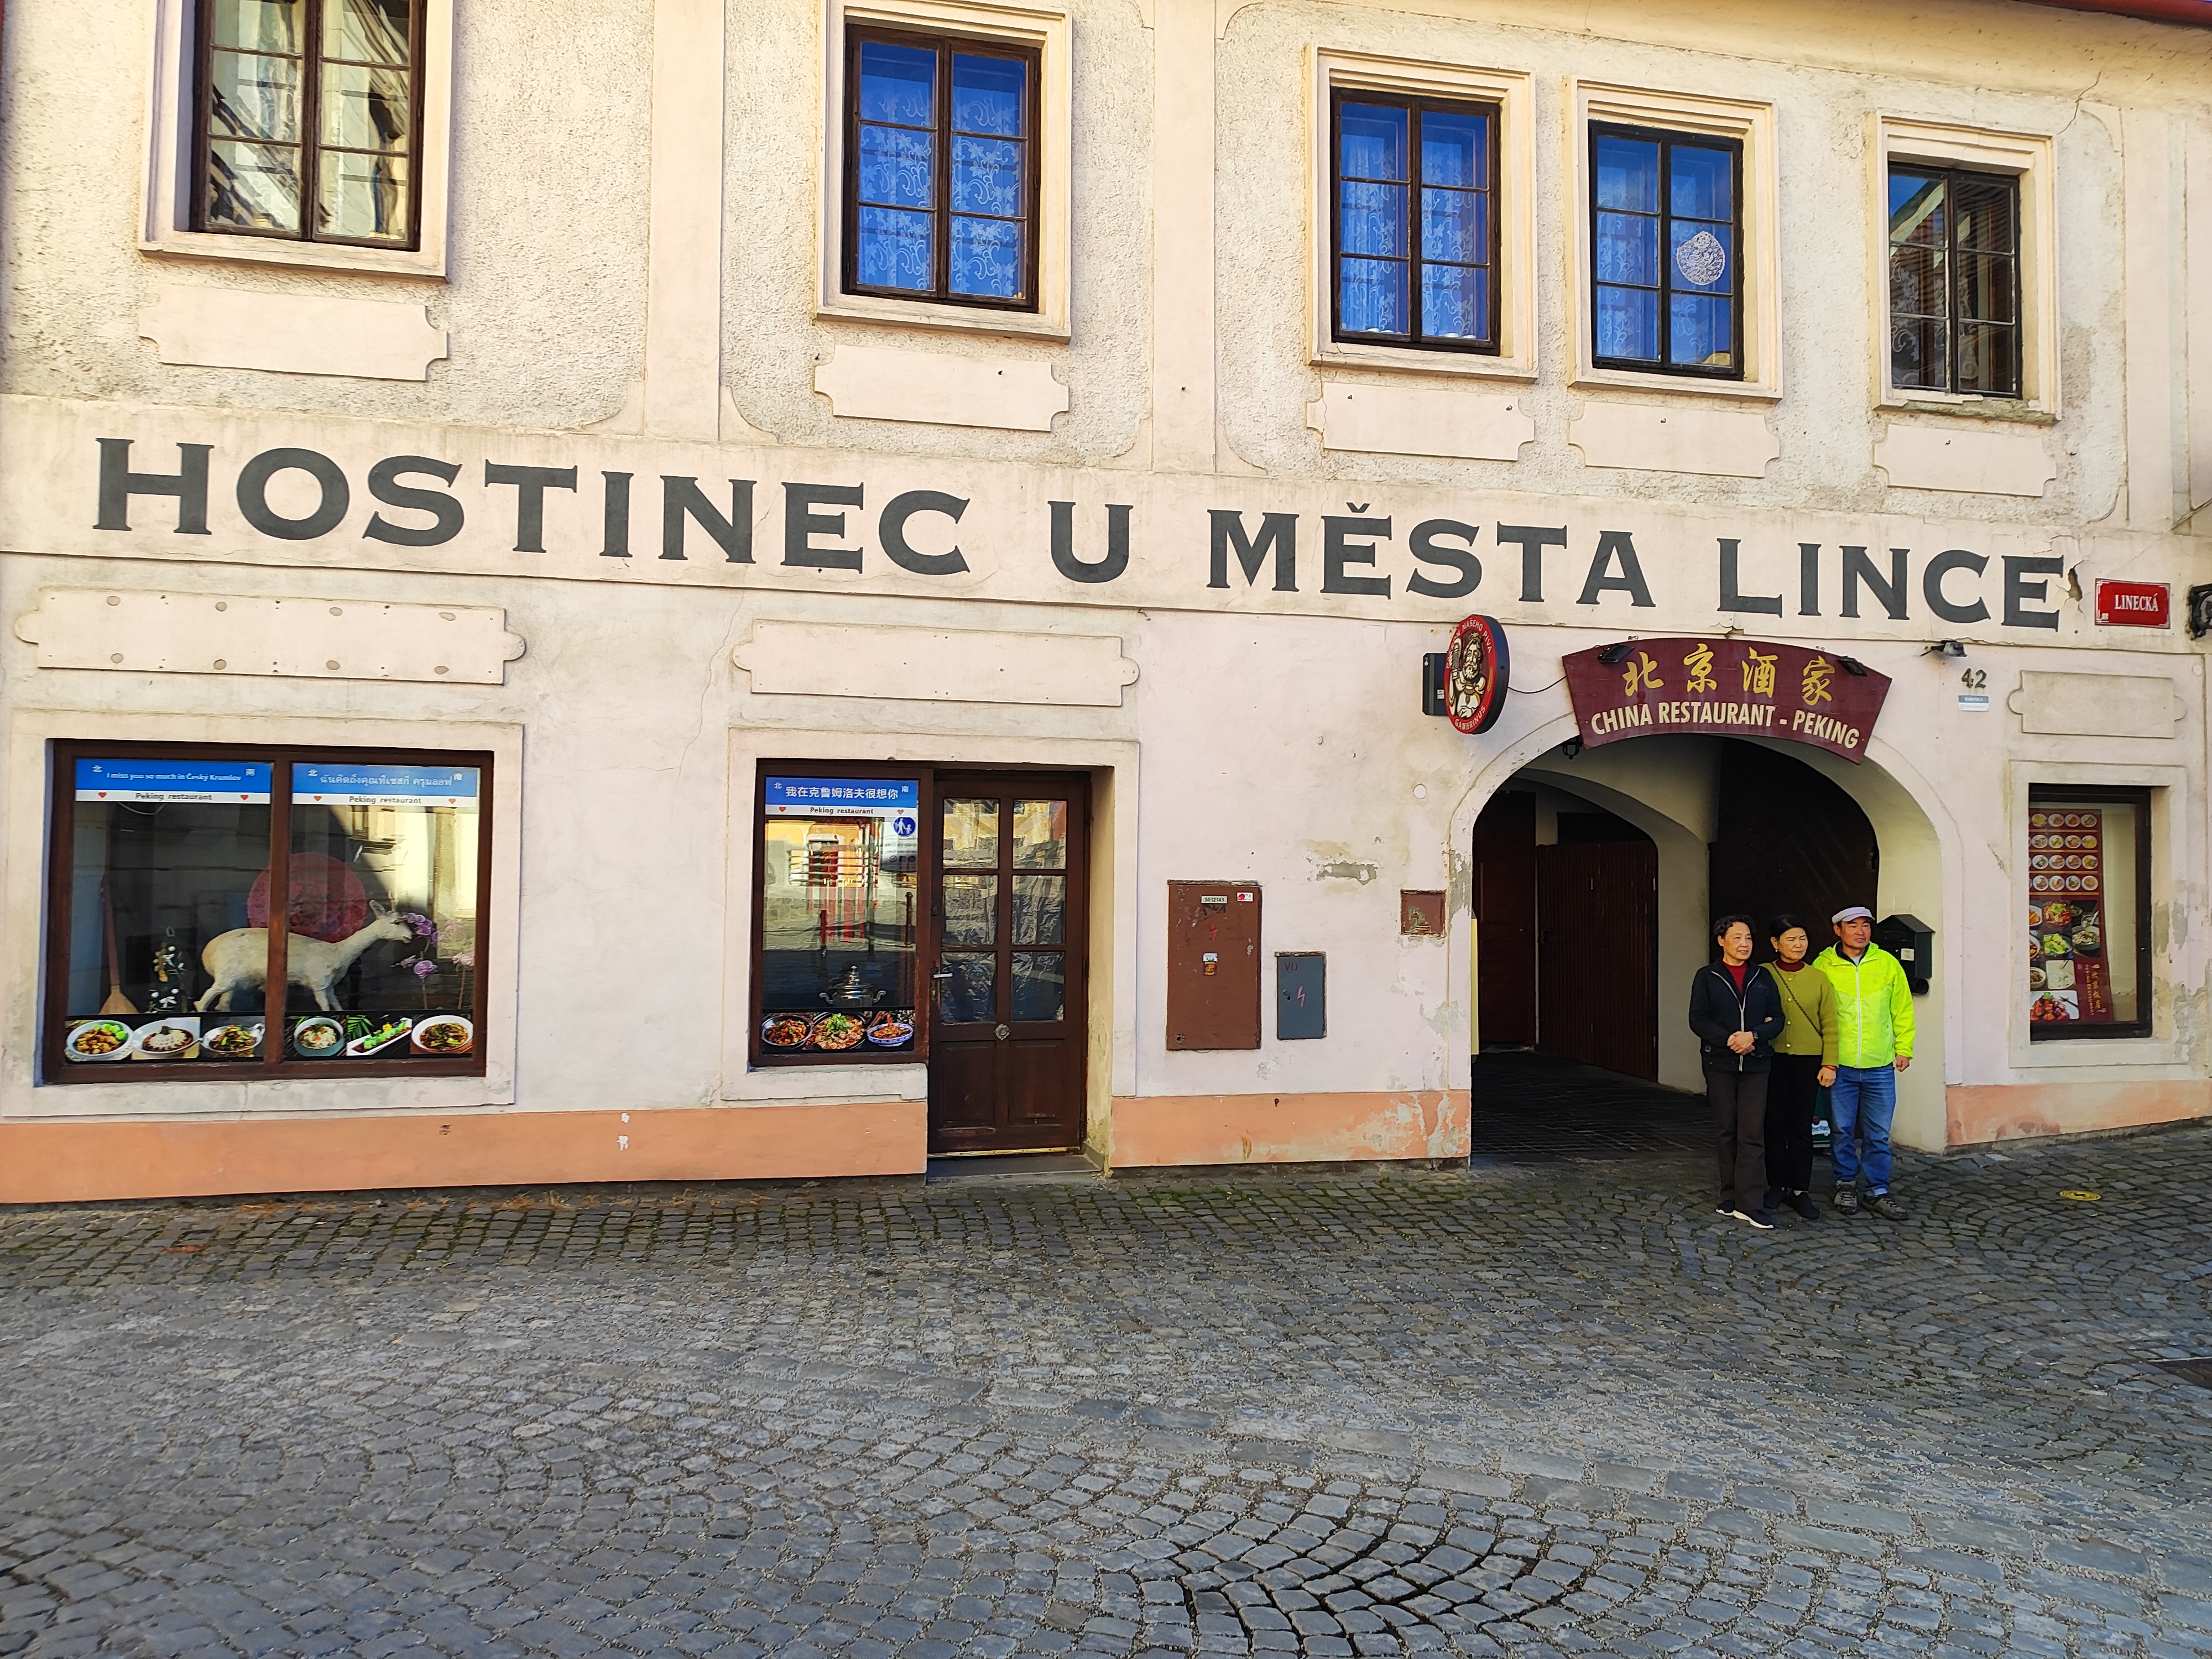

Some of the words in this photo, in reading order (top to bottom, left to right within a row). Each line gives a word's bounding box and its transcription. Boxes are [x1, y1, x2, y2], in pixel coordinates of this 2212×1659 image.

[93, 437, 970, 575] HOSTINEC
[1047, 501, 1134, 583] U
[1207, 502, 1656, 608] MĚSTA
[1717, 538, 2064, 632] LINCE
[2114, 592, 2159, 612] LINECKÁ
[1482, 630, 1492, 654] PIVA
[1622, 643, 1835, 706] 北京酒家
[1961, 667, 1987, 689] 42
[1454, 705, 1485, 730] GAMBRINUS
[1591, 703, 1653, 735] CHINA
[1658, 701, 1776, 727] RESTAURANT
[1792, 709, 1860, 749] PEKING
[135, 792, 164, 801] Peking
[349, 796, 376, 805] Peking
[785, 786, 899, 800] 我在克鲁姆洛夫很想你
[810, 806, 834, 815] Peking
